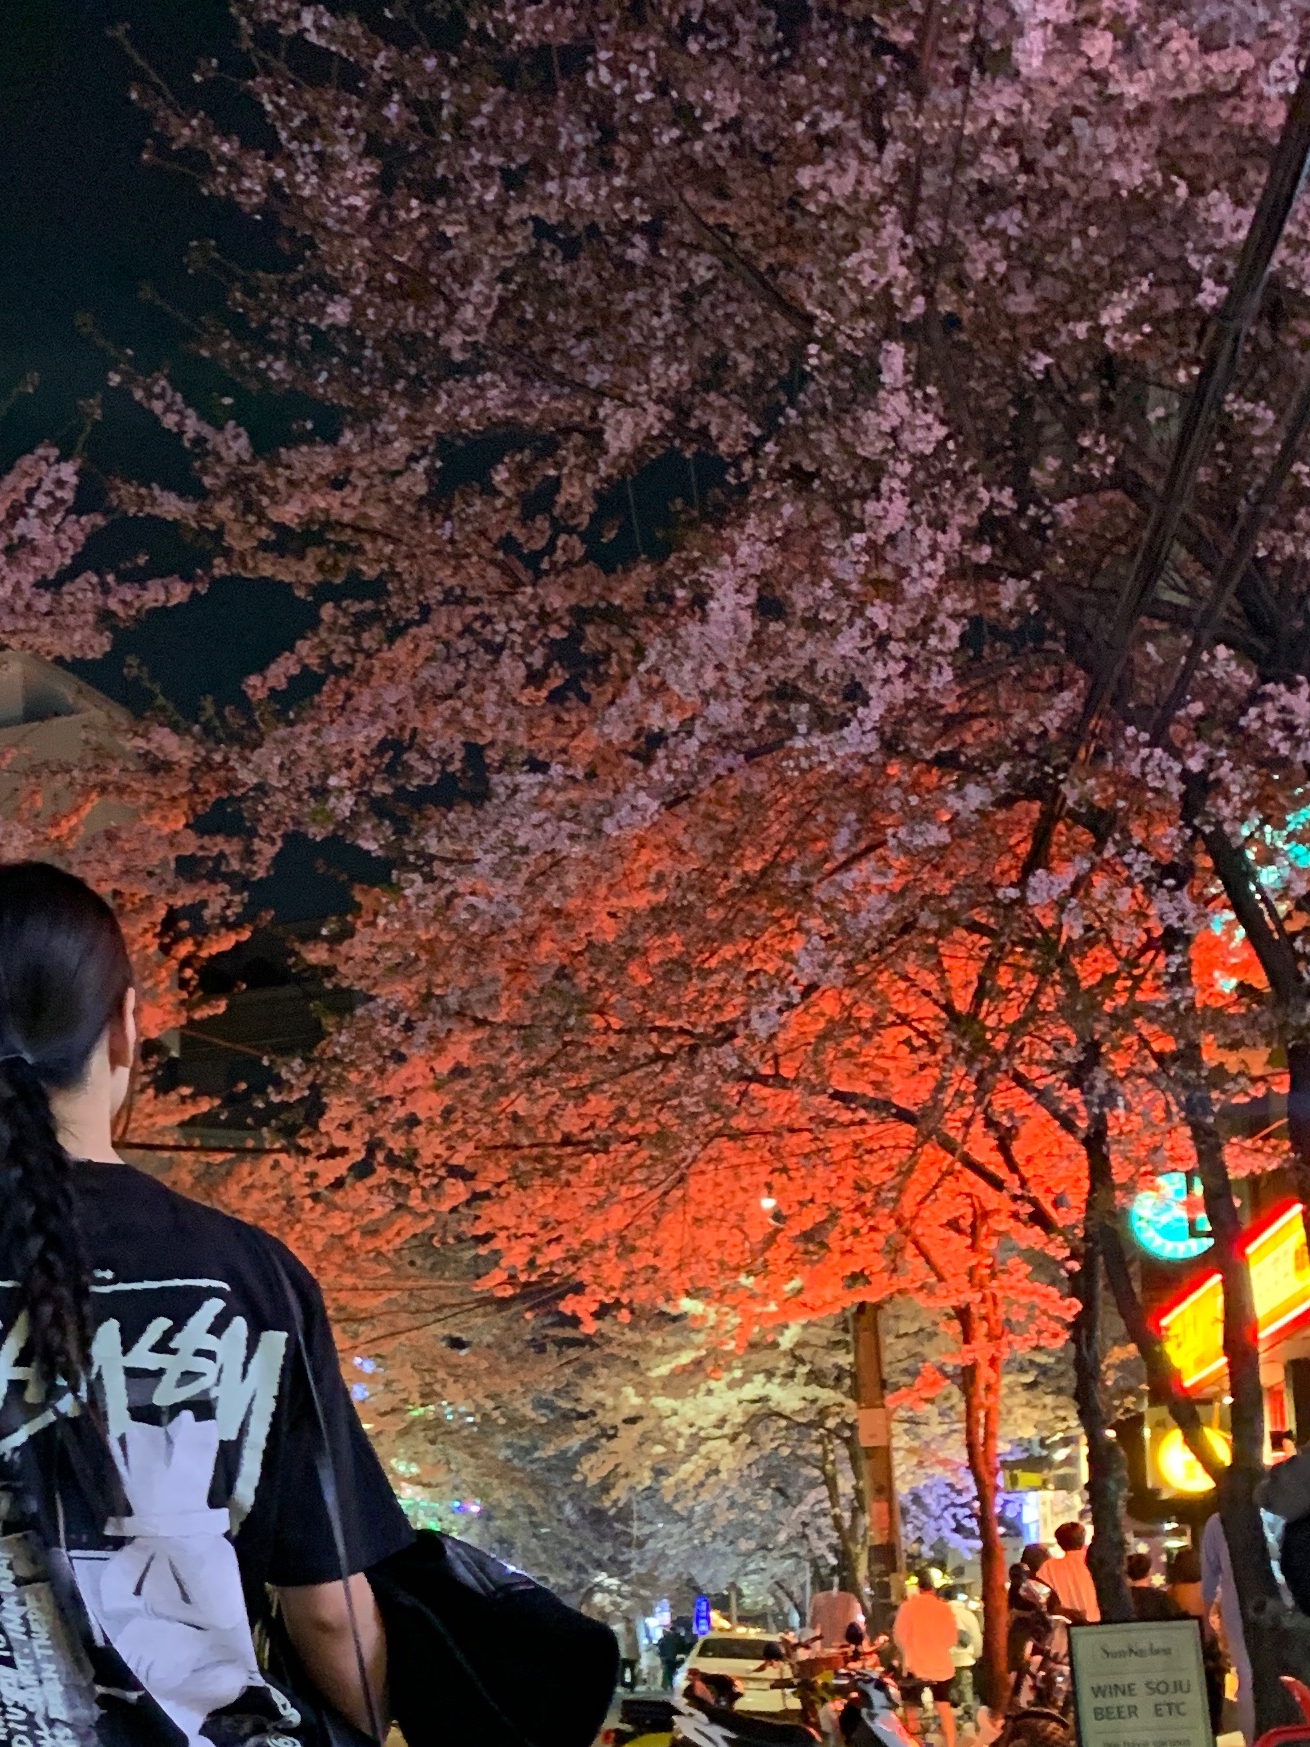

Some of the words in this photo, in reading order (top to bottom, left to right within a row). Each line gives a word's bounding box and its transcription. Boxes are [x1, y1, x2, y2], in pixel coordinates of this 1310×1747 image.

[1091, 1682, 1137, 1699] WINE
[1144, 1679, 1191, 1697] SOJU
[1094, 1705, 1139, 1721] BEER
[1154, 1702, 1188, 1717] ETC
